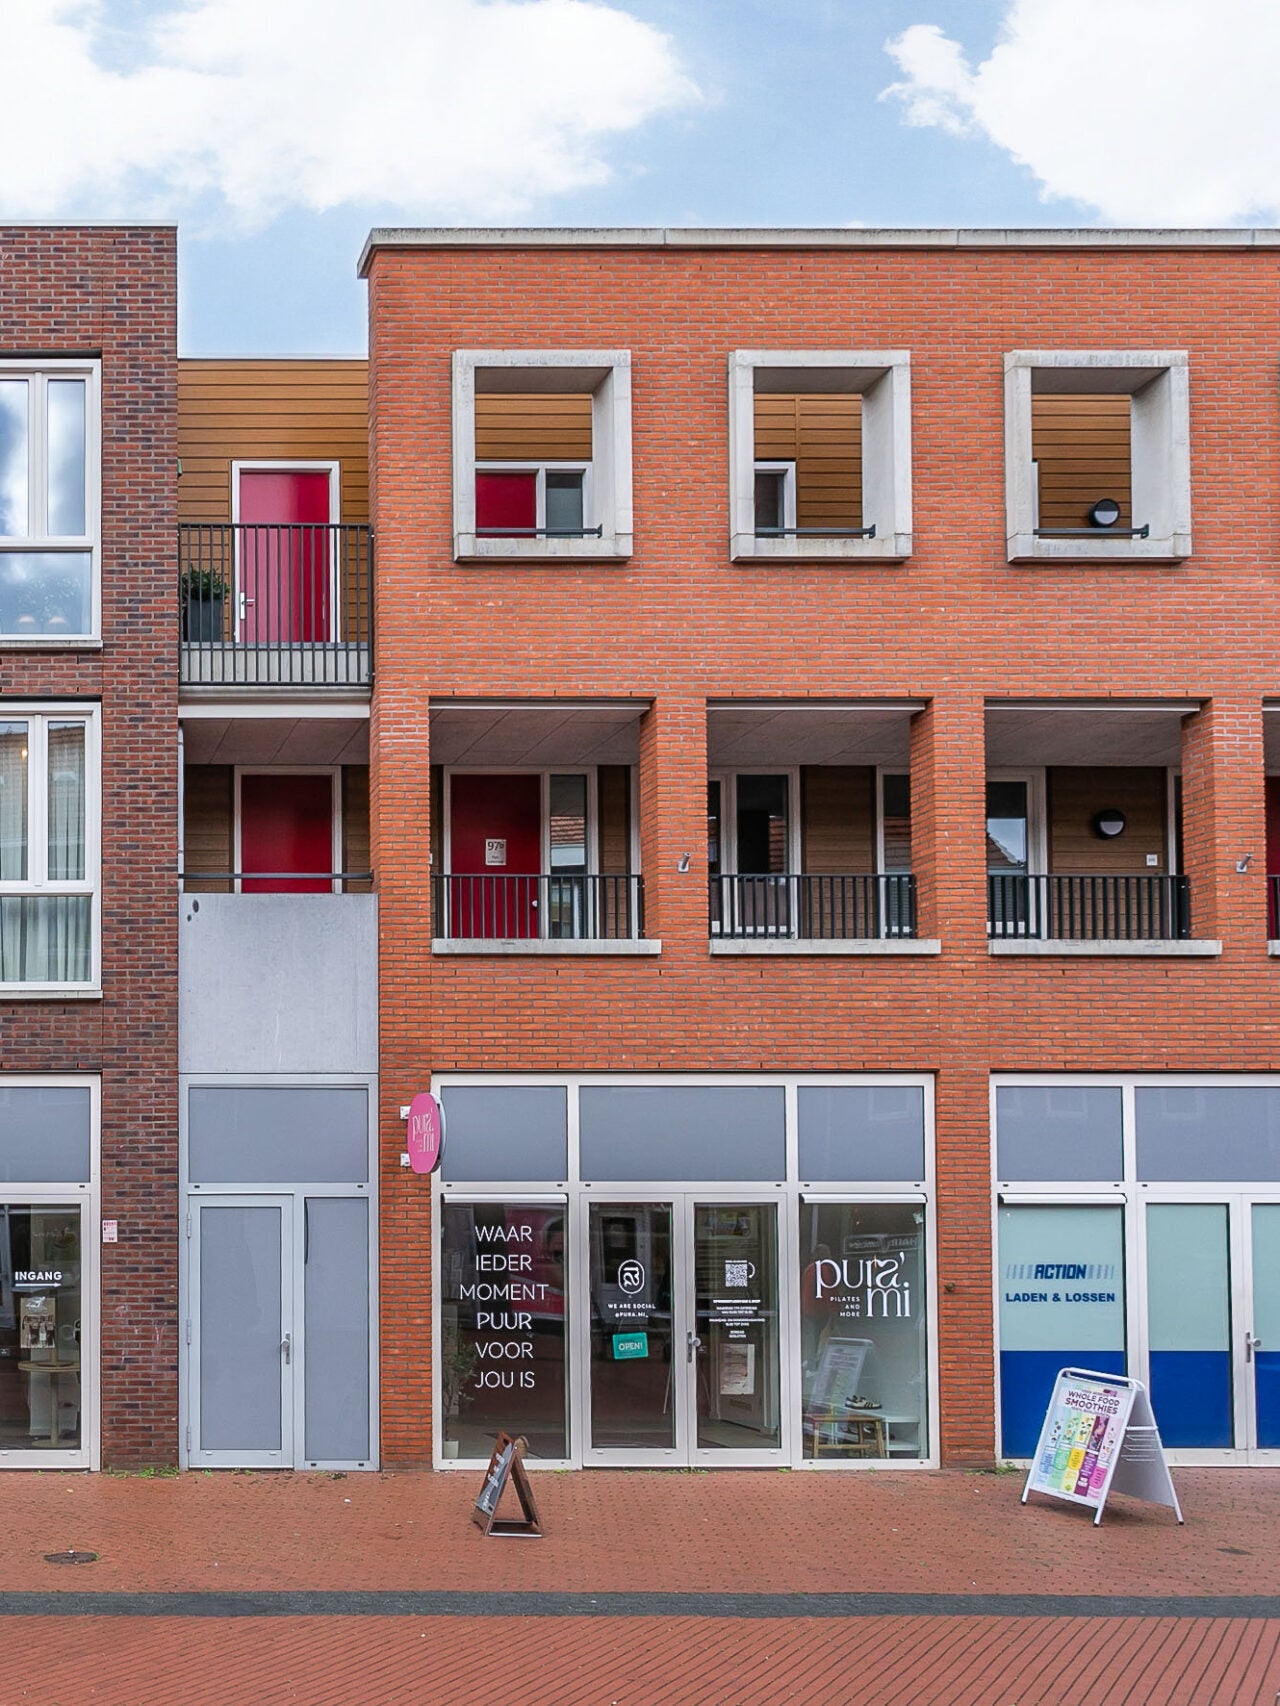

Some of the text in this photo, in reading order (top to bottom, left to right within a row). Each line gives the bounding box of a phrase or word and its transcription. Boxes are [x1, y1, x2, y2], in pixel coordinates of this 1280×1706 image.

[475, 1225, 533, 1242] WAAR
[475, 1254, 532, 1271] IEDER
[14, 1271, 62, 1281] INGANG
[1034, 1264, 1087, 1279] ACTION
[460, 1284, 549, 1301] MOMENT
[866, 1282, 911, 1317] mi
[1005, 1292, 1115, 1302] LADEN & LOSSEN
[476, 1312, 532, 1330] PUUR
[474, 1341, 534, 1359] VOOR
[474, 1371, 535, 1388] JOU IS
[1065, 1397, 1118, 1415] SMOOTHIES
[1068, 1390, 1097, 1402] WHOLE
[1098, 1396, 1120, 1407] FOOD
